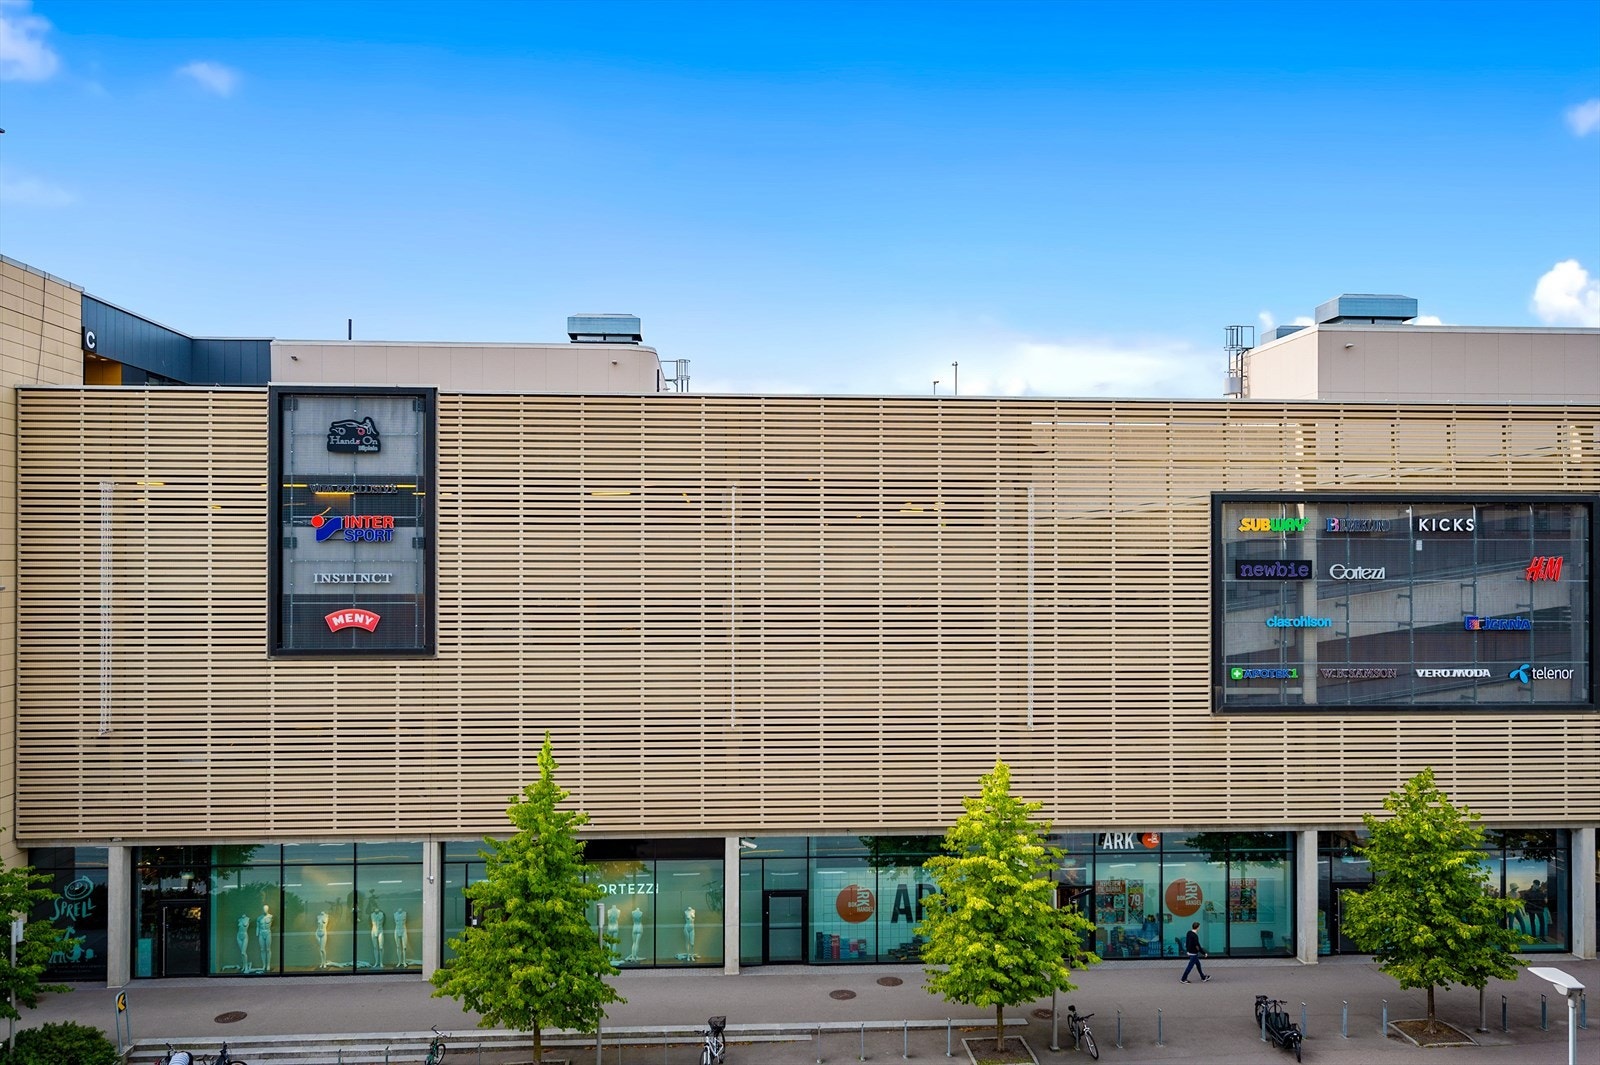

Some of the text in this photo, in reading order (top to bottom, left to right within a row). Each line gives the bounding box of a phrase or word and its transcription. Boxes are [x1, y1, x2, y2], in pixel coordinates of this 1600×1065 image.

[87, 331, 96, 349] C
[362, 436, 378, 445] On
[344, 515, 394, 528] INTER
[1239, 517, 1310, 532] SUBWAY
[1418, 518, 1474, 532] KICKS
[344, 529, 394, 542] SPORT
[1240, 561, 1309, 577] newbie
[1330, 564, 1385, 579] Cortezzi
[1525, 556, 1563, 582] H&M
[313, 573, 393, 583] INSTINCT
[331, 613, 374, 626] MENY
[1266, 615, 1332, 627] clas ohlson
[1244, 668, 1290, 679] APOTEK
[1349, 668, 1397, 679] SAMSON
[1415, 669, 1491, 678] VERO MODA
[1531, 667, 1574, 680] telenor
[1103, 832, 1134, 849] ARK
[597, 883, 659, 895] ORTEZZI
[49, 896, 96, 922] SPRELL
